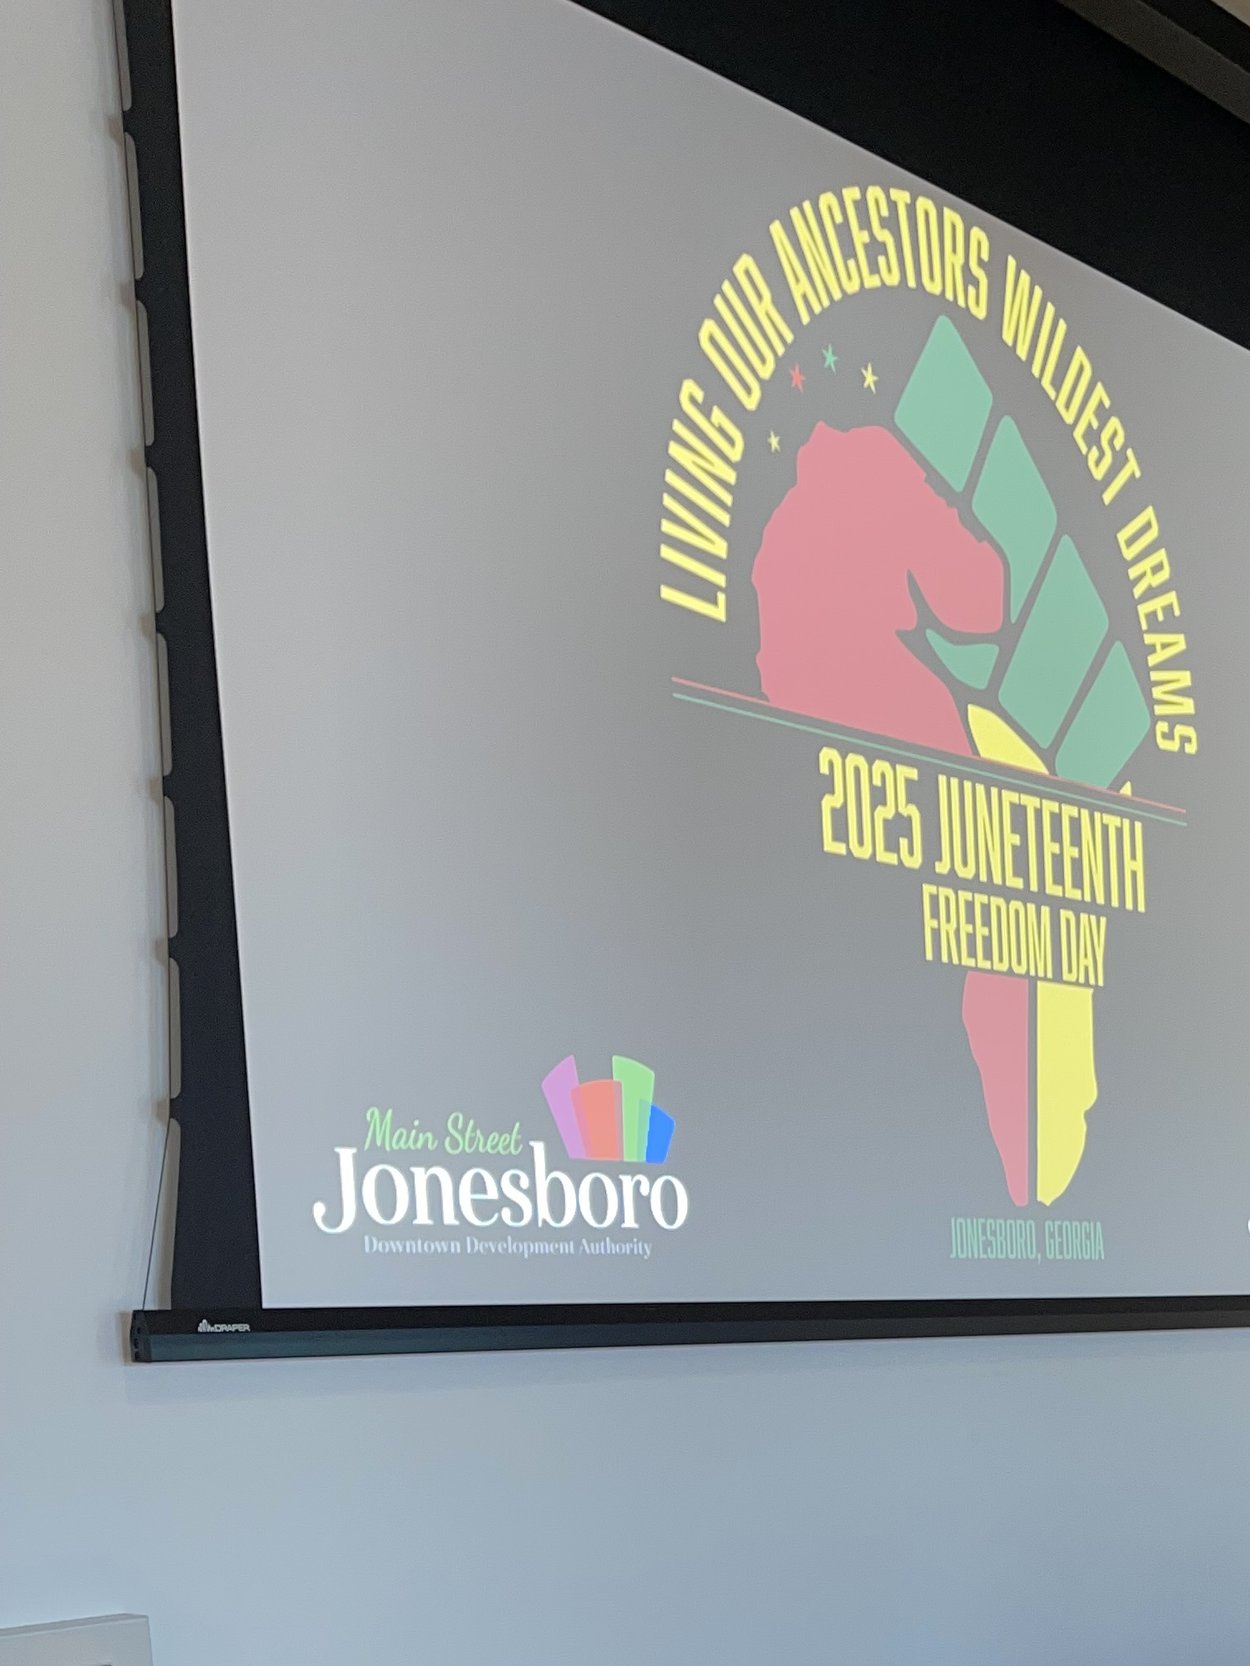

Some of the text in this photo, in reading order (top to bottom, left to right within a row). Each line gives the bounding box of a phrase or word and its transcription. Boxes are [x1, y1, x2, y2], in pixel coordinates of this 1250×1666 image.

[660, 185, 1198, 755] LIVING OUR ANCESTORS WILDEST DREAMS
[819, 746, 1146, 913] 2025 JUNETEENTH
[922, 883, 1107, 987] FREEDOM DAY
[364, 1107, 523, 1155] Main Street
[312, 1140, 689, 1234] Jonesboro
[364, 1235, 653, 1260] Downtown Development Authority
[1045, 1220, 1105, 1260] GEORGIA
[214, 1323, 250, 1333] DRAPER
